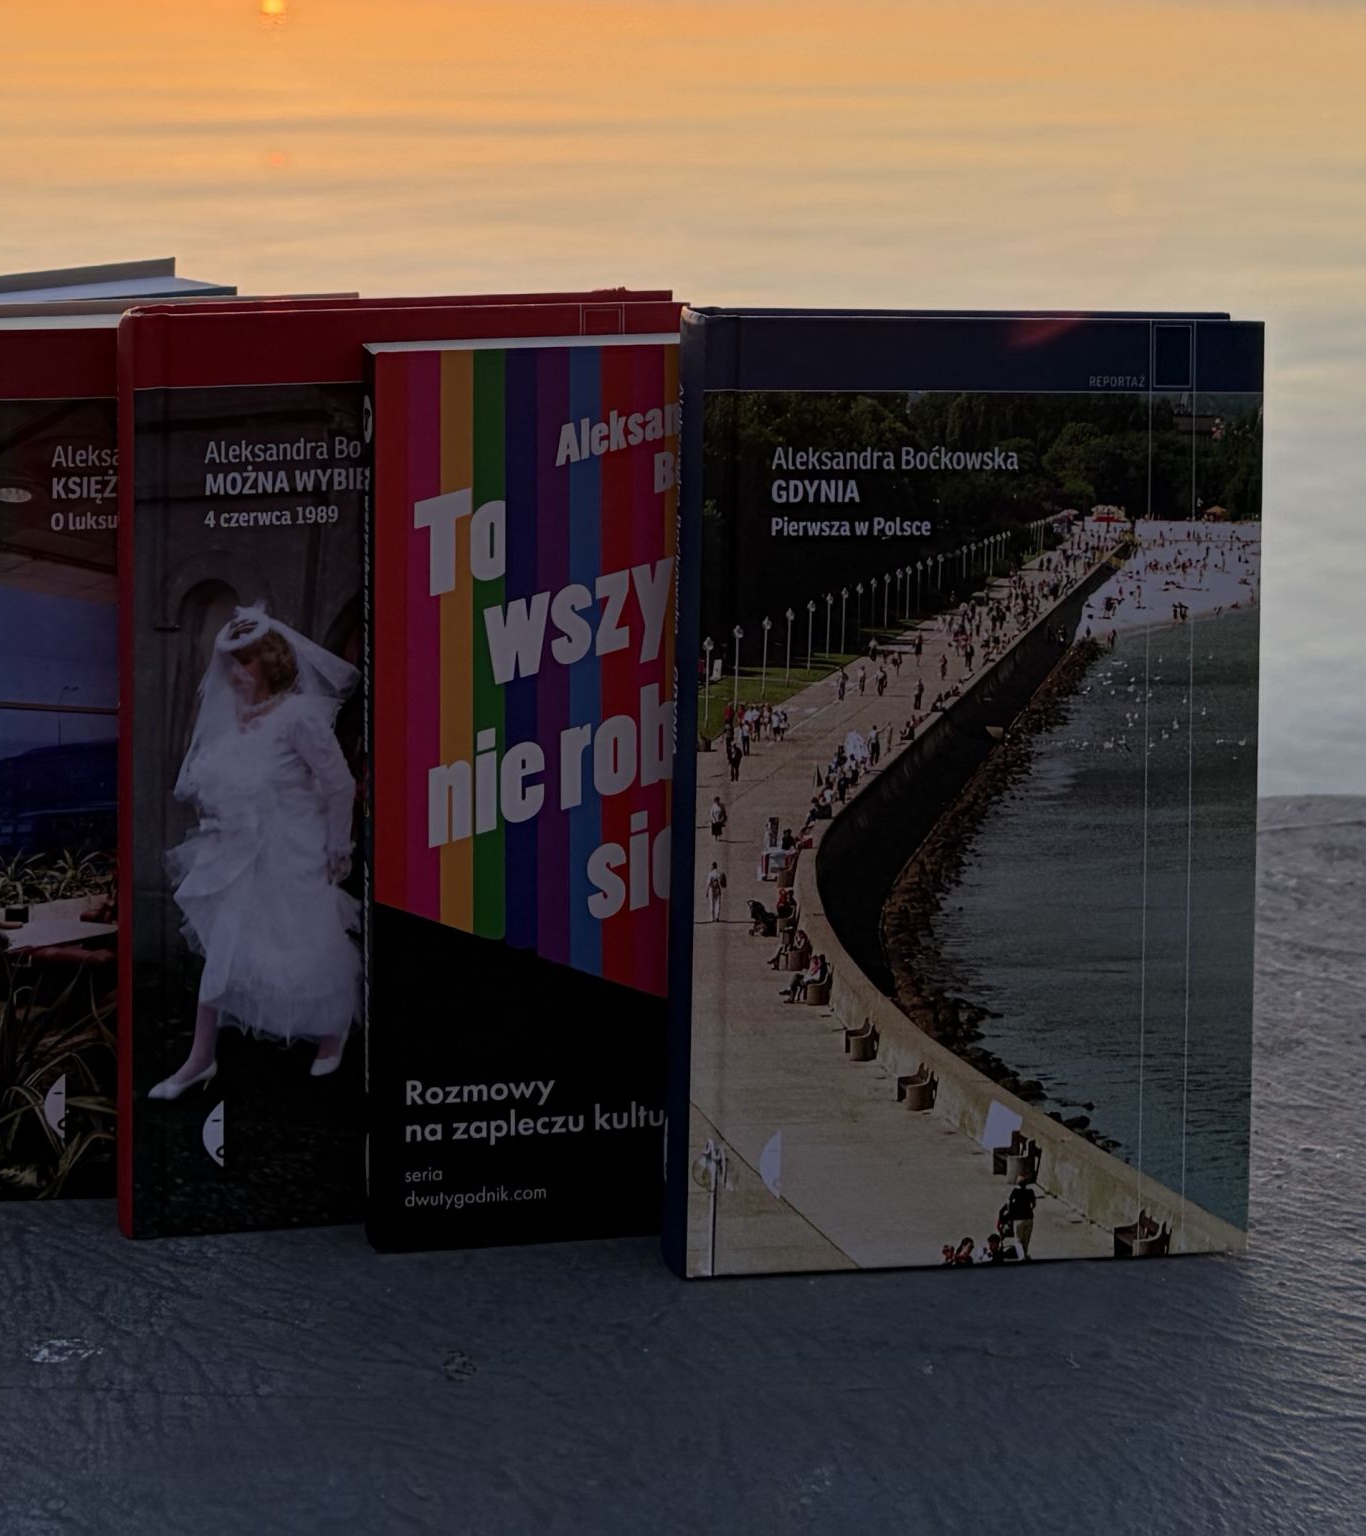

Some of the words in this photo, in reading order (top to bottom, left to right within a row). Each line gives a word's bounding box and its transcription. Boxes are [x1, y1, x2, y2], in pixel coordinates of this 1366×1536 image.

[204, 437, 329, 465] Aleksandra
[335, 436, 361, 459] Bo
[771, 446, 895, 470] Aleksandra
[901, 446, 1019, 470] Boćkowska
[51, 468, 119, 504] KSIĘŻ
[204, 464, 290, 496] MOŻNA
[771, 479, 860, 503] GDYNIA
[50, 512, 64, 531] O
[68, 511, 118, 530] luksu
[204, 512, 215, 527] 4
[221, 510, 291, 527] czerwca
[296, 505, 339, 524] 1989
[771, 517, 850, 536] Pierwsza
[855, 522, 869, 535] w
[873, 517, 932, 536] Polsce
[413, 487, 506, 597] To
[483, 557, 674, 685] wszy
[428, 727, 545, 848] nie
[560, 682, 674, 810] rob
[404, 1079, 556, 1106] Rozmowy
[404, 1123, 443, 1144] na
[452, 1110, 584, 1146] zapleczu
[594, 1100, 664, 1131] kultu
[404, 1166, 443, 1183] seria
[404, 1185, 547, 1211] dwutygodnik.com
